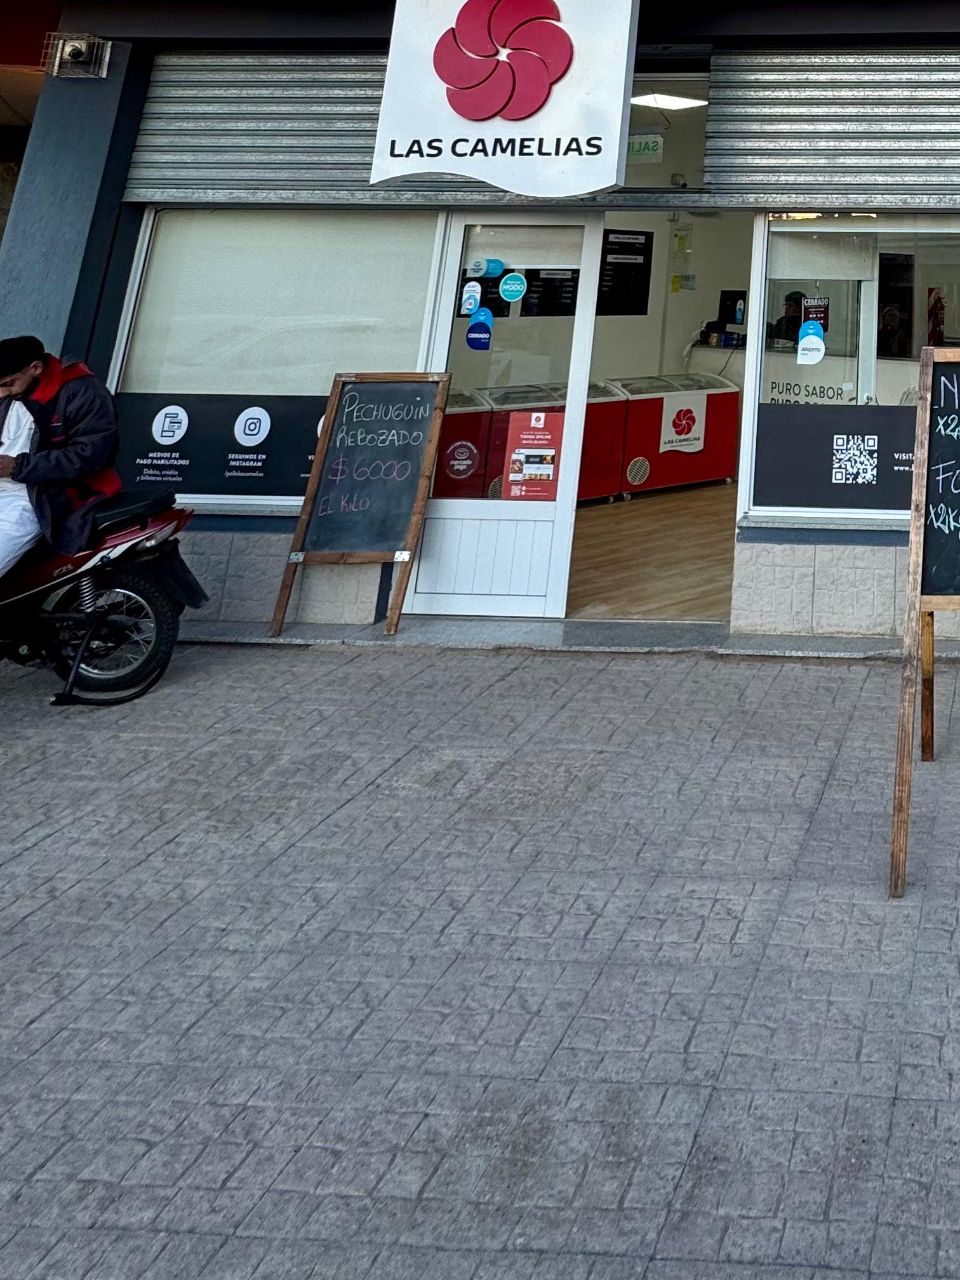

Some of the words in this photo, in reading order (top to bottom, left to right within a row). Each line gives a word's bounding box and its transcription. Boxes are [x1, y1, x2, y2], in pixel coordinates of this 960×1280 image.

[389, 138, 443, 158] LAS
[450, 136, 603, 157] CAMELIAS
[770, 381, 801, 396] PURO
[804, 384, 844, 400] SABOR
[336, 425, 424, 449] REBOZADO
[893, 452, 915, 460] VISIT
[318, 494, 334, 517] EL
